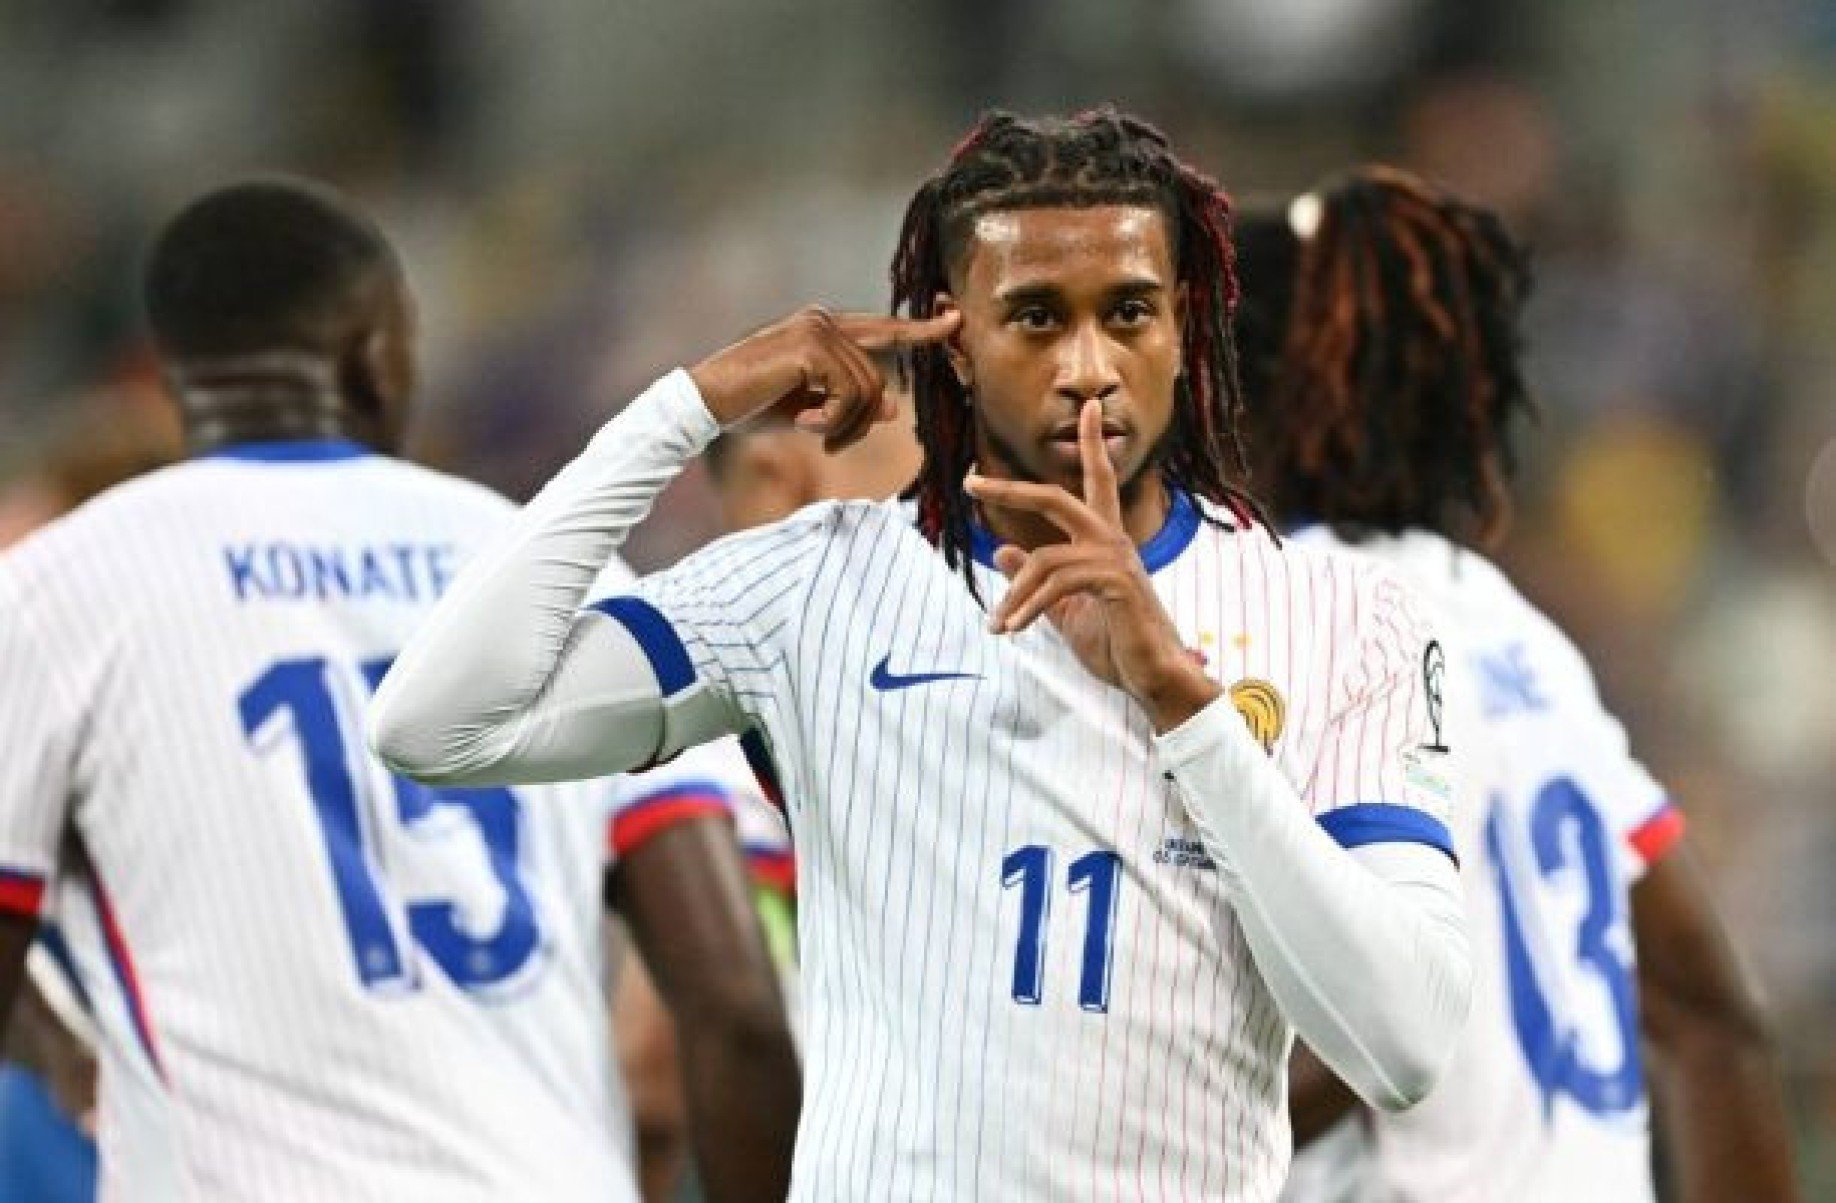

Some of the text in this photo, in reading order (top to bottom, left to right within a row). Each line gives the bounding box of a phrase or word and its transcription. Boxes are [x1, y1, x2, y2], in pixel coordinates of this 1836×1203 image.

[237, 655, 543, 992] 15
[1002, 844, 1122, 1013] 11
[1486, 776, 1645, 1118] 13
